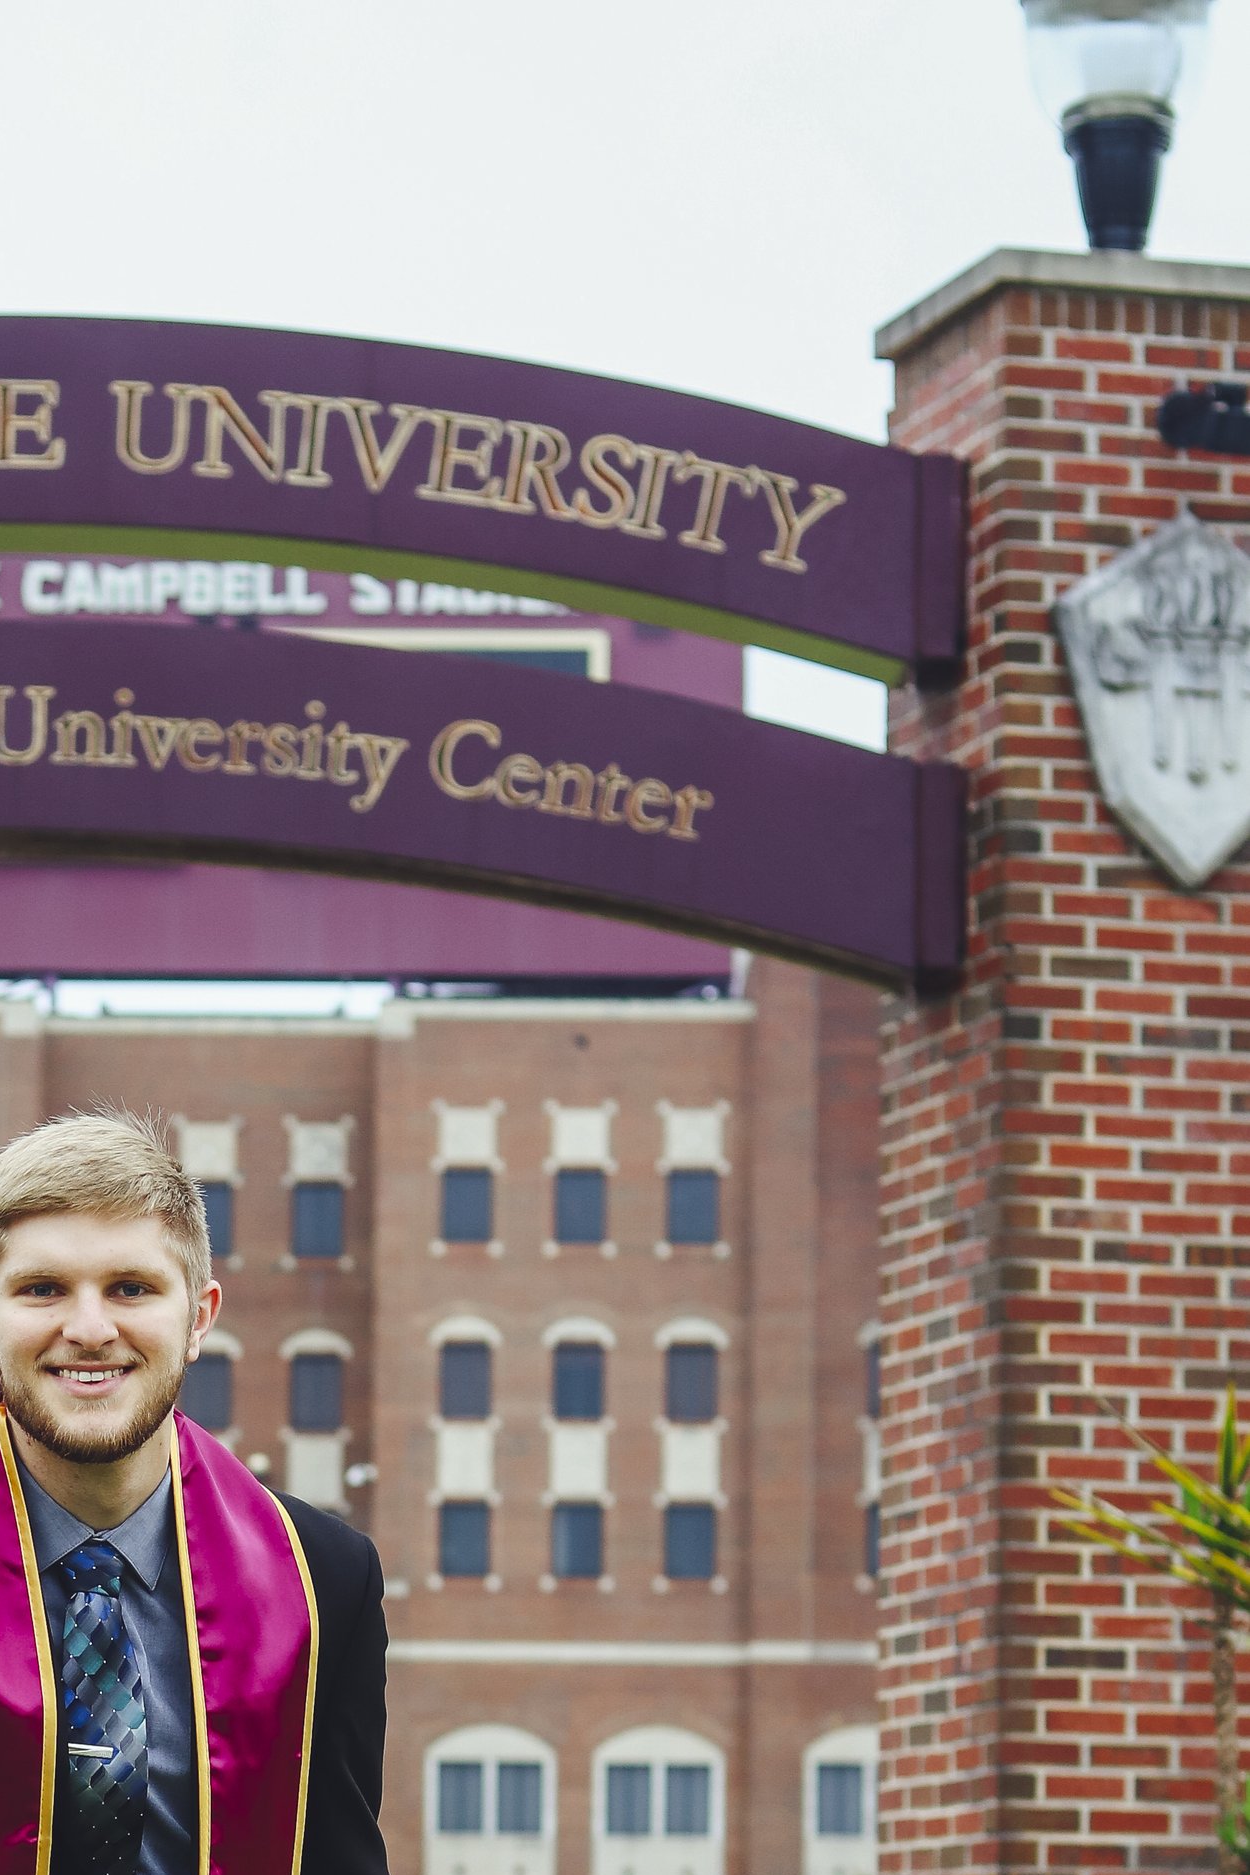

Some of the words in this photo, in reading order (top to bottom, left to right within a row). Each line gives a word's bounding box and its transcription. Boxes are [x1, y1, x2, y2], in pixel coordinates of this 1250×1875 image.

[109, 378, 846, 574] UNIVERSITY
[20, 559, 330, 617] CAMPBELL
[428, 717, 715, 842] Center
